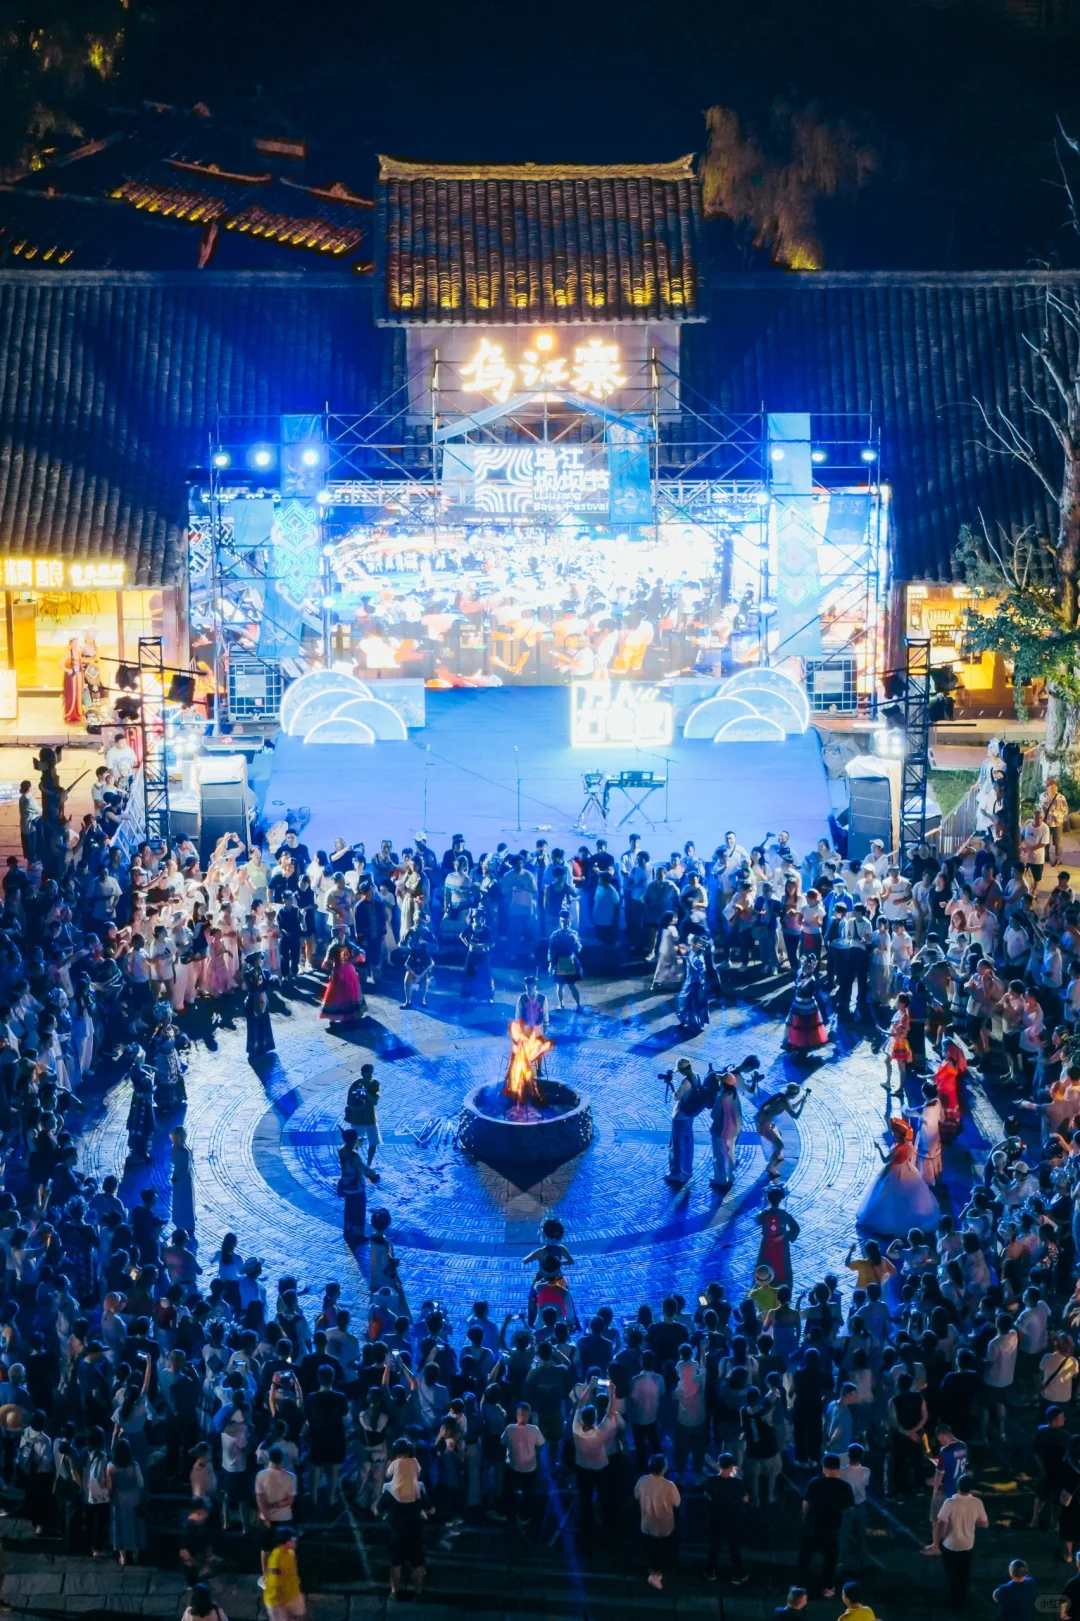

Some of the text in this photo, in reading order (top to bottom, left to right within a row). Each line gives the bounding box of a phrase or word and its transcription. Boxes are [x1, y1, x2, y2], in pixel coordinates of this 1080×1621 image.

[459, 338, 627, 402] 乌江寨
[535, 448, 584, 469] 乌江
[534, 470, 609, 491] 坝坝节
[566, 501, 609, 511] Festival
[0, 559, 64, 587] 精酿
